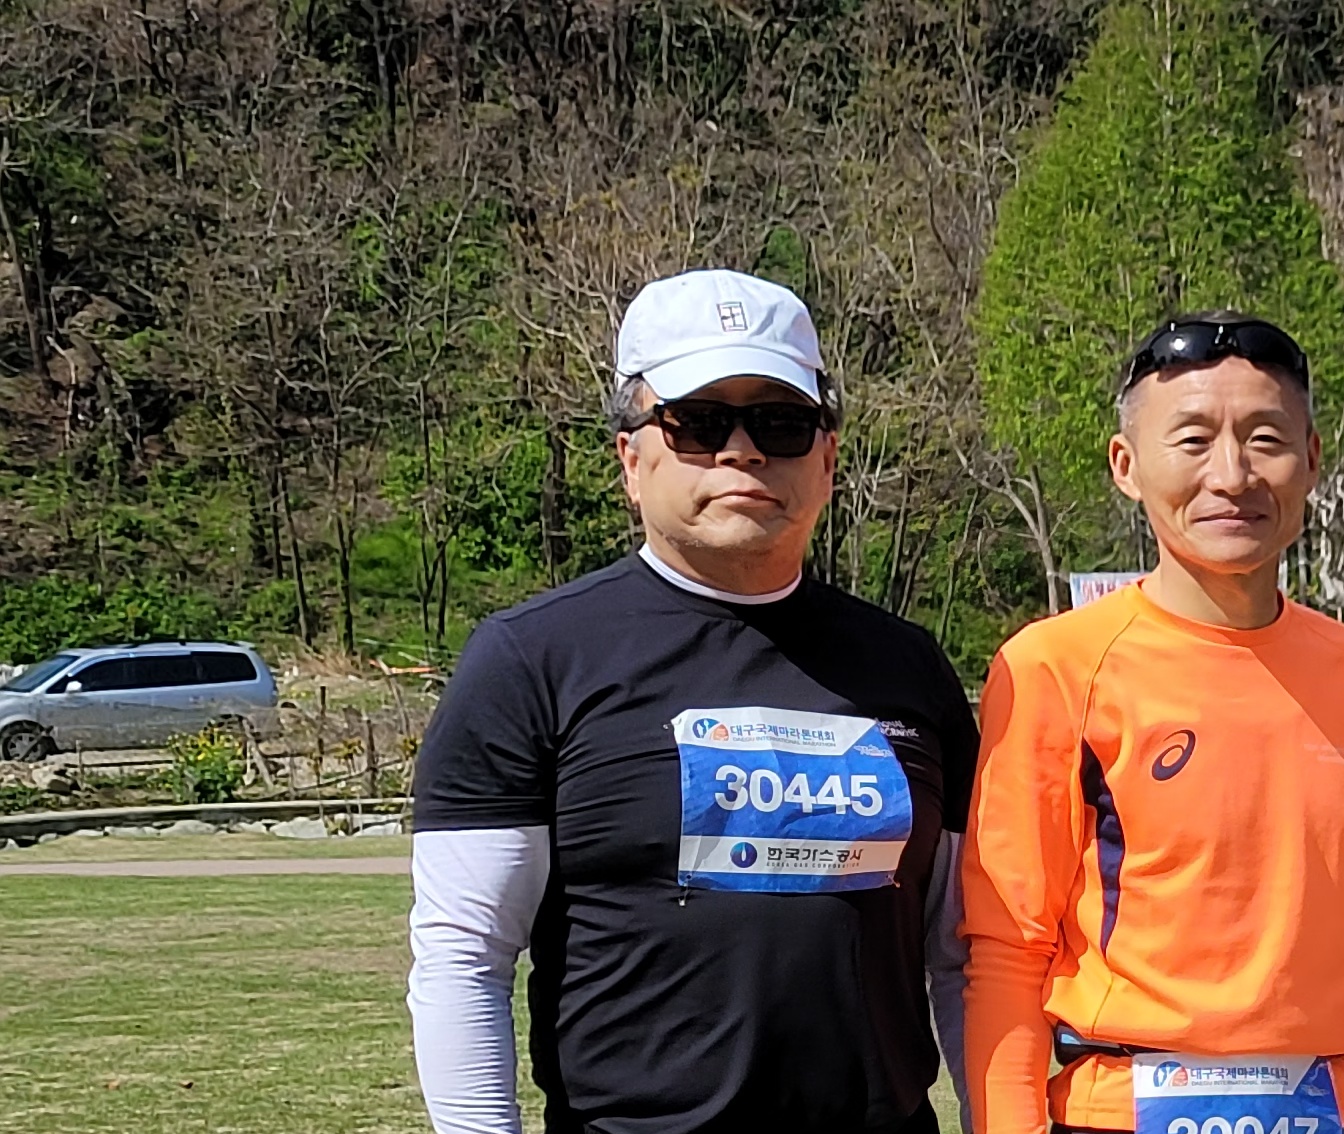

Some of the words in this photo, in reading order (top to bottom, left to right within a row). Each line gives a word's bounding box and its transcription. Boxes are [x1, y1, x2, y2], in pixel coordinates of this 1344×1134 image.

[730, 723, 836, 742] 대구국제마라톤대회
[714, 764, 883, 817] 30445
[767, 846, 864, 863] 한국가스공사
[1190, 1066, 1289, 1080] 대구국제마라톤대회
